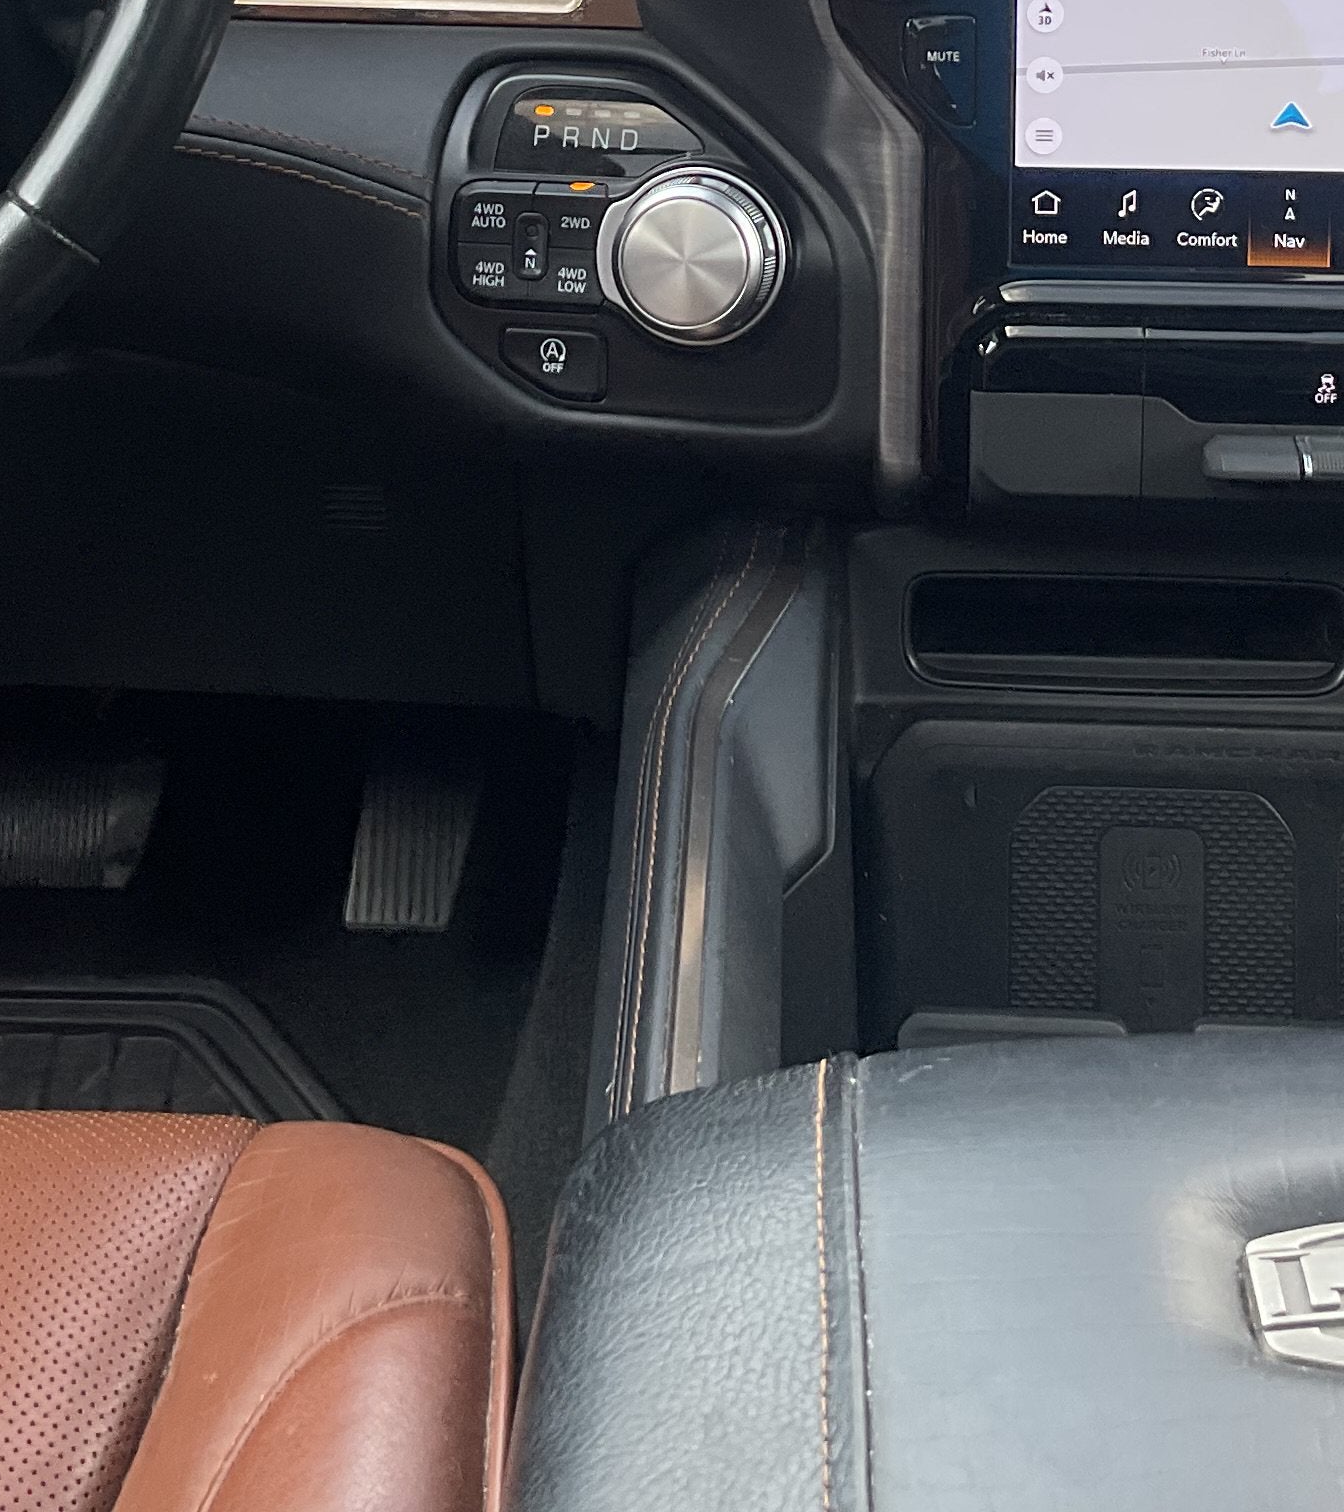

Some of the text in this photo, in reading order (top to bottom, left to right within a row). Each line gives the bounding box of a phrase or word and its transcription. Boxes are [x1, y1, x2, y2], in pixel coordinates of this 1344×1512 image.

[1037, 14, 1052, 26] 3D
[927, 50, 960, 62] MUTE
[1285, 189, 1296, 201] N
[474, 202, 505, 215] 4WD
[471, 216, 507, 229] AUTO
[561, 216, 591, 229] 2WD
[1023, 230, 1068, 245] Home
[1102, 231, 1150, 246] Media
[1176, 232, 1238, 248] Comfort
[1274, 233, 1305, 249] Nav
[475, 261, 505, 274] 4WD
[524, 257, 536, 269] N
[557, 267, 587, 280] 4WD
[472, 274, 505, 287] HIGH
[557, 280, 587, 294] LOW
[542, 363, 564, 373] OFF
[1314, 392, 1338, 404] OFF
